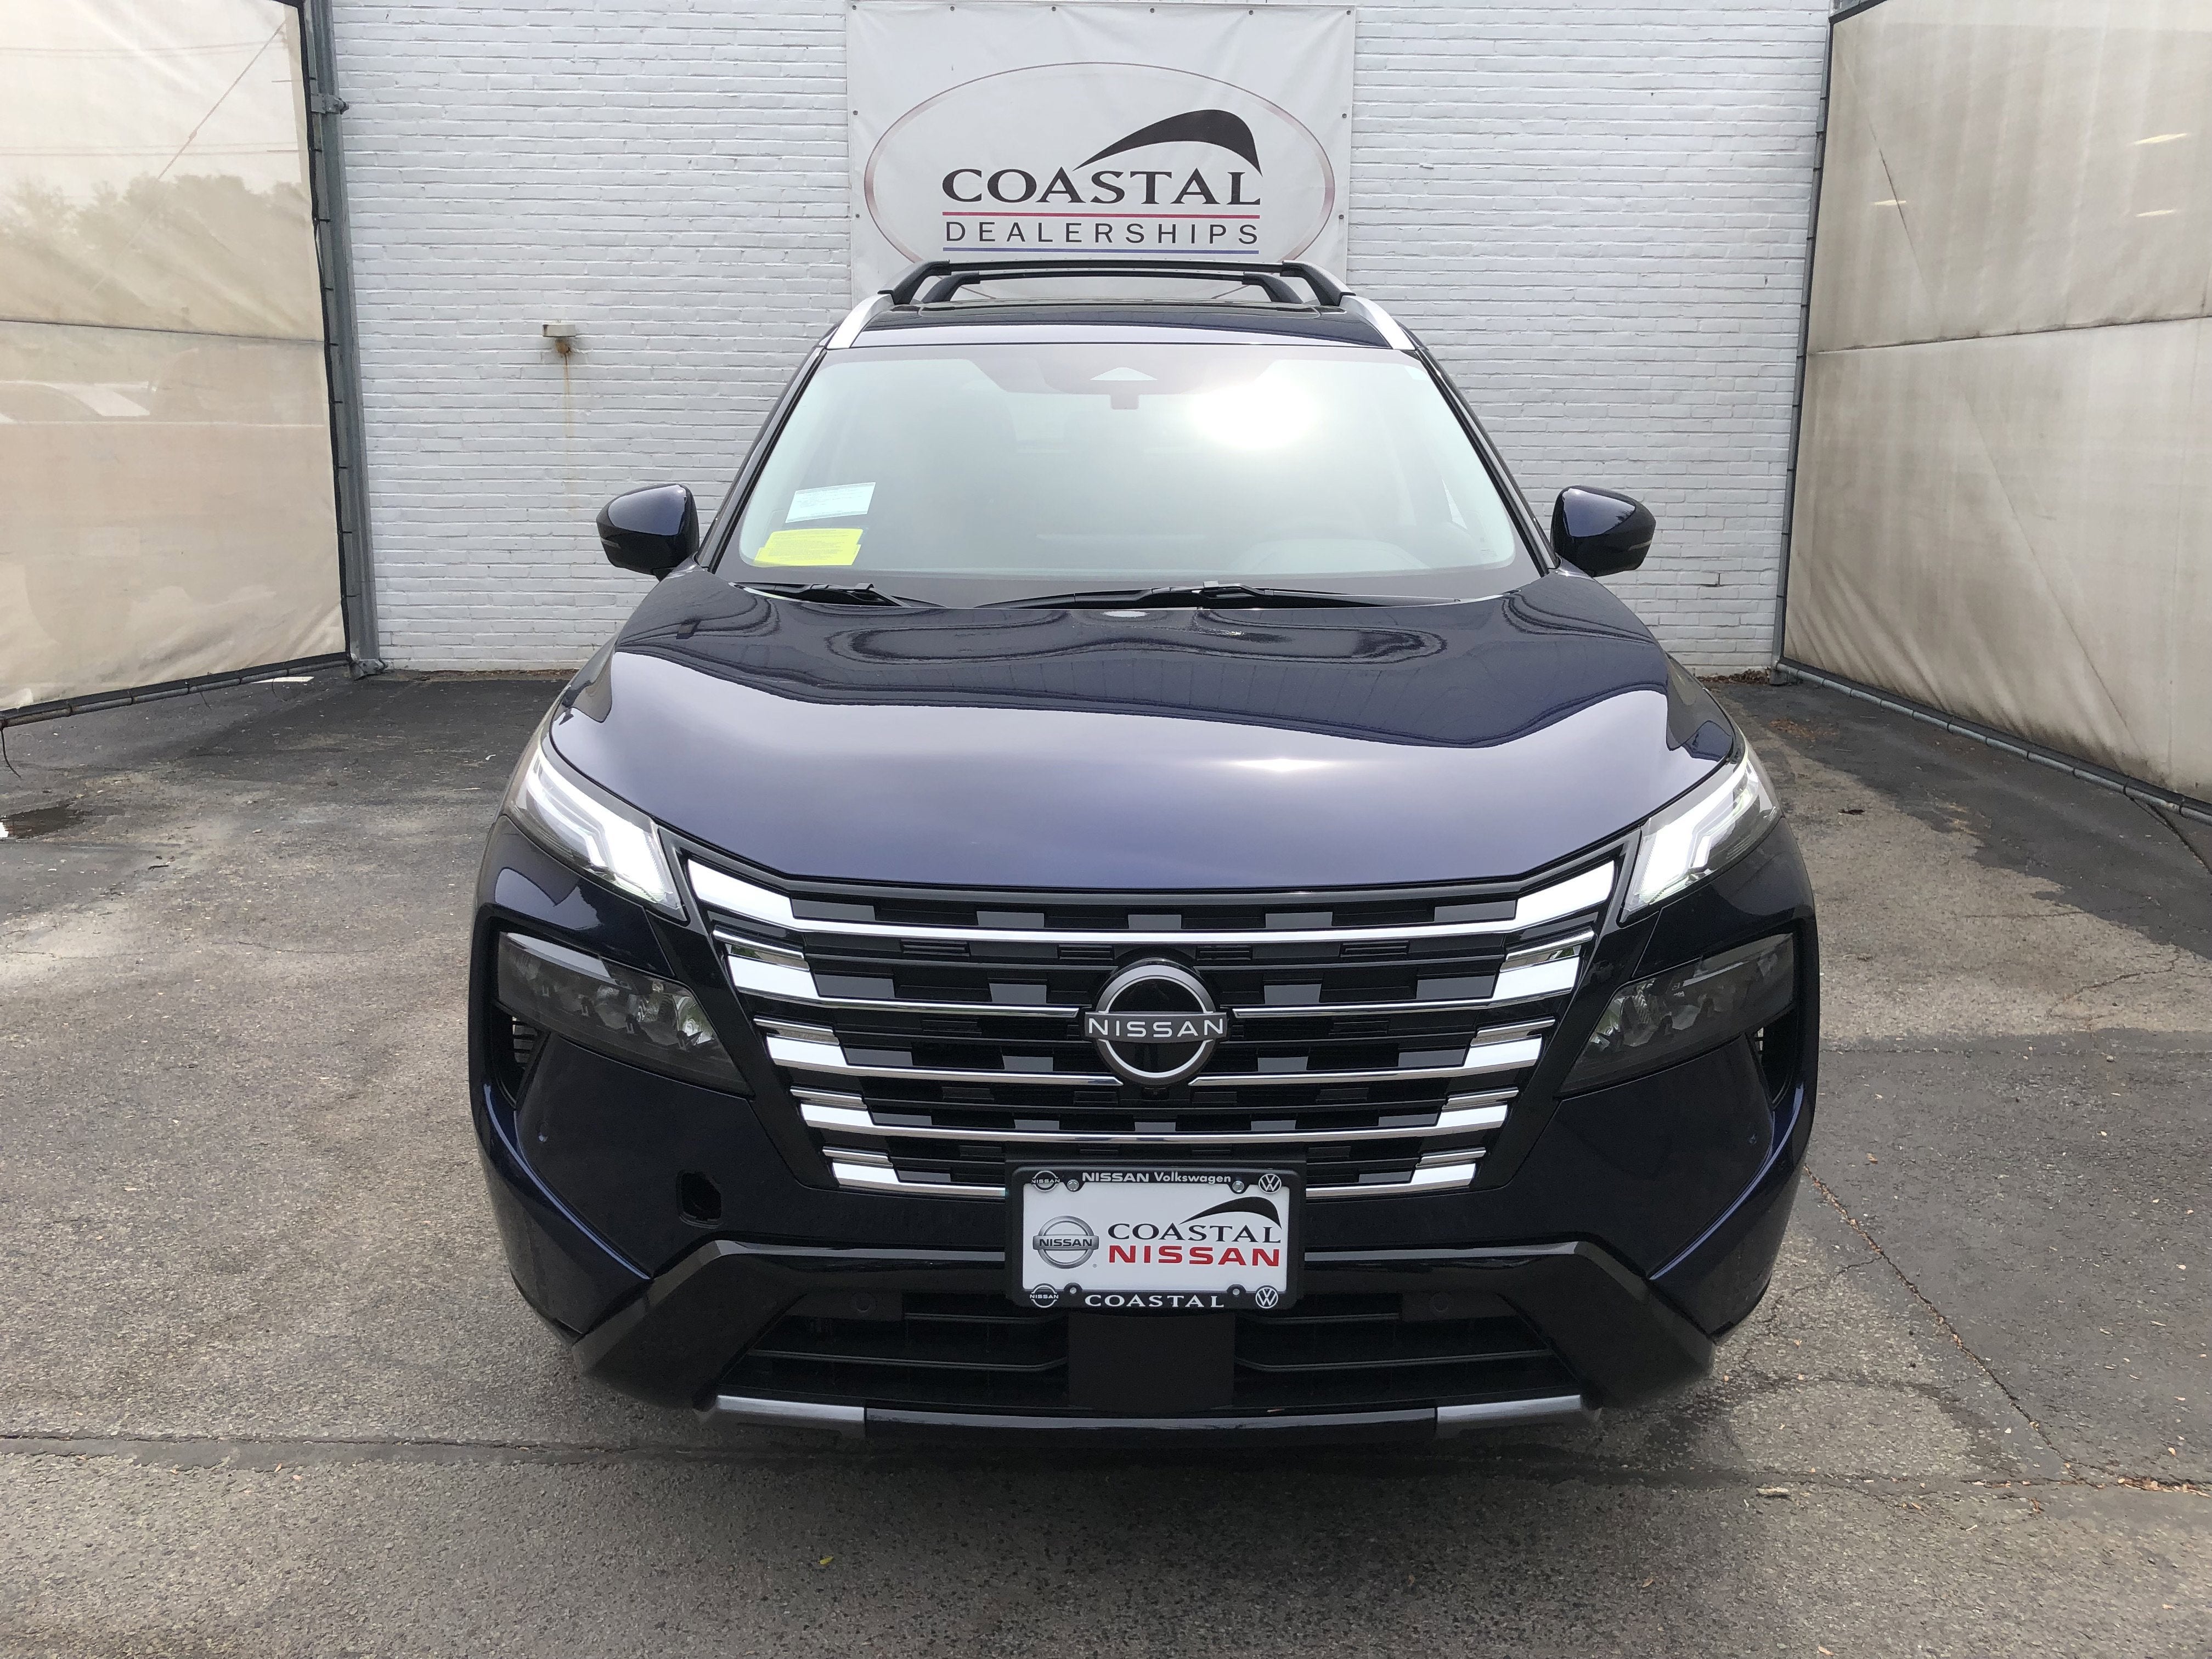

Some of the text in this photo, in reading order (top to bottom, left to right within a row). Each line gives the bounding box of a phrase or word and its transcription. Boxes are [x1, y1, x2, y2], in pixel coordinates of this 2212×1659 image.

[941, 166, 1261, 206] COASTAL
[946, 221, 1259, 245] DEALERSHIPS
[1088, 1018, 1223, 1037] NISSAN
[1082, 1171, 1231, 1184] NISSAN Volkswagen
[1039, 1237, 1093, 1247] NISSAN
[1107, 1222, 1282, 1244] COASTAL
[1108, 1244, 1280, 1267] NISSAN
[1085, 1294, 1224, 1308] COASTAL
